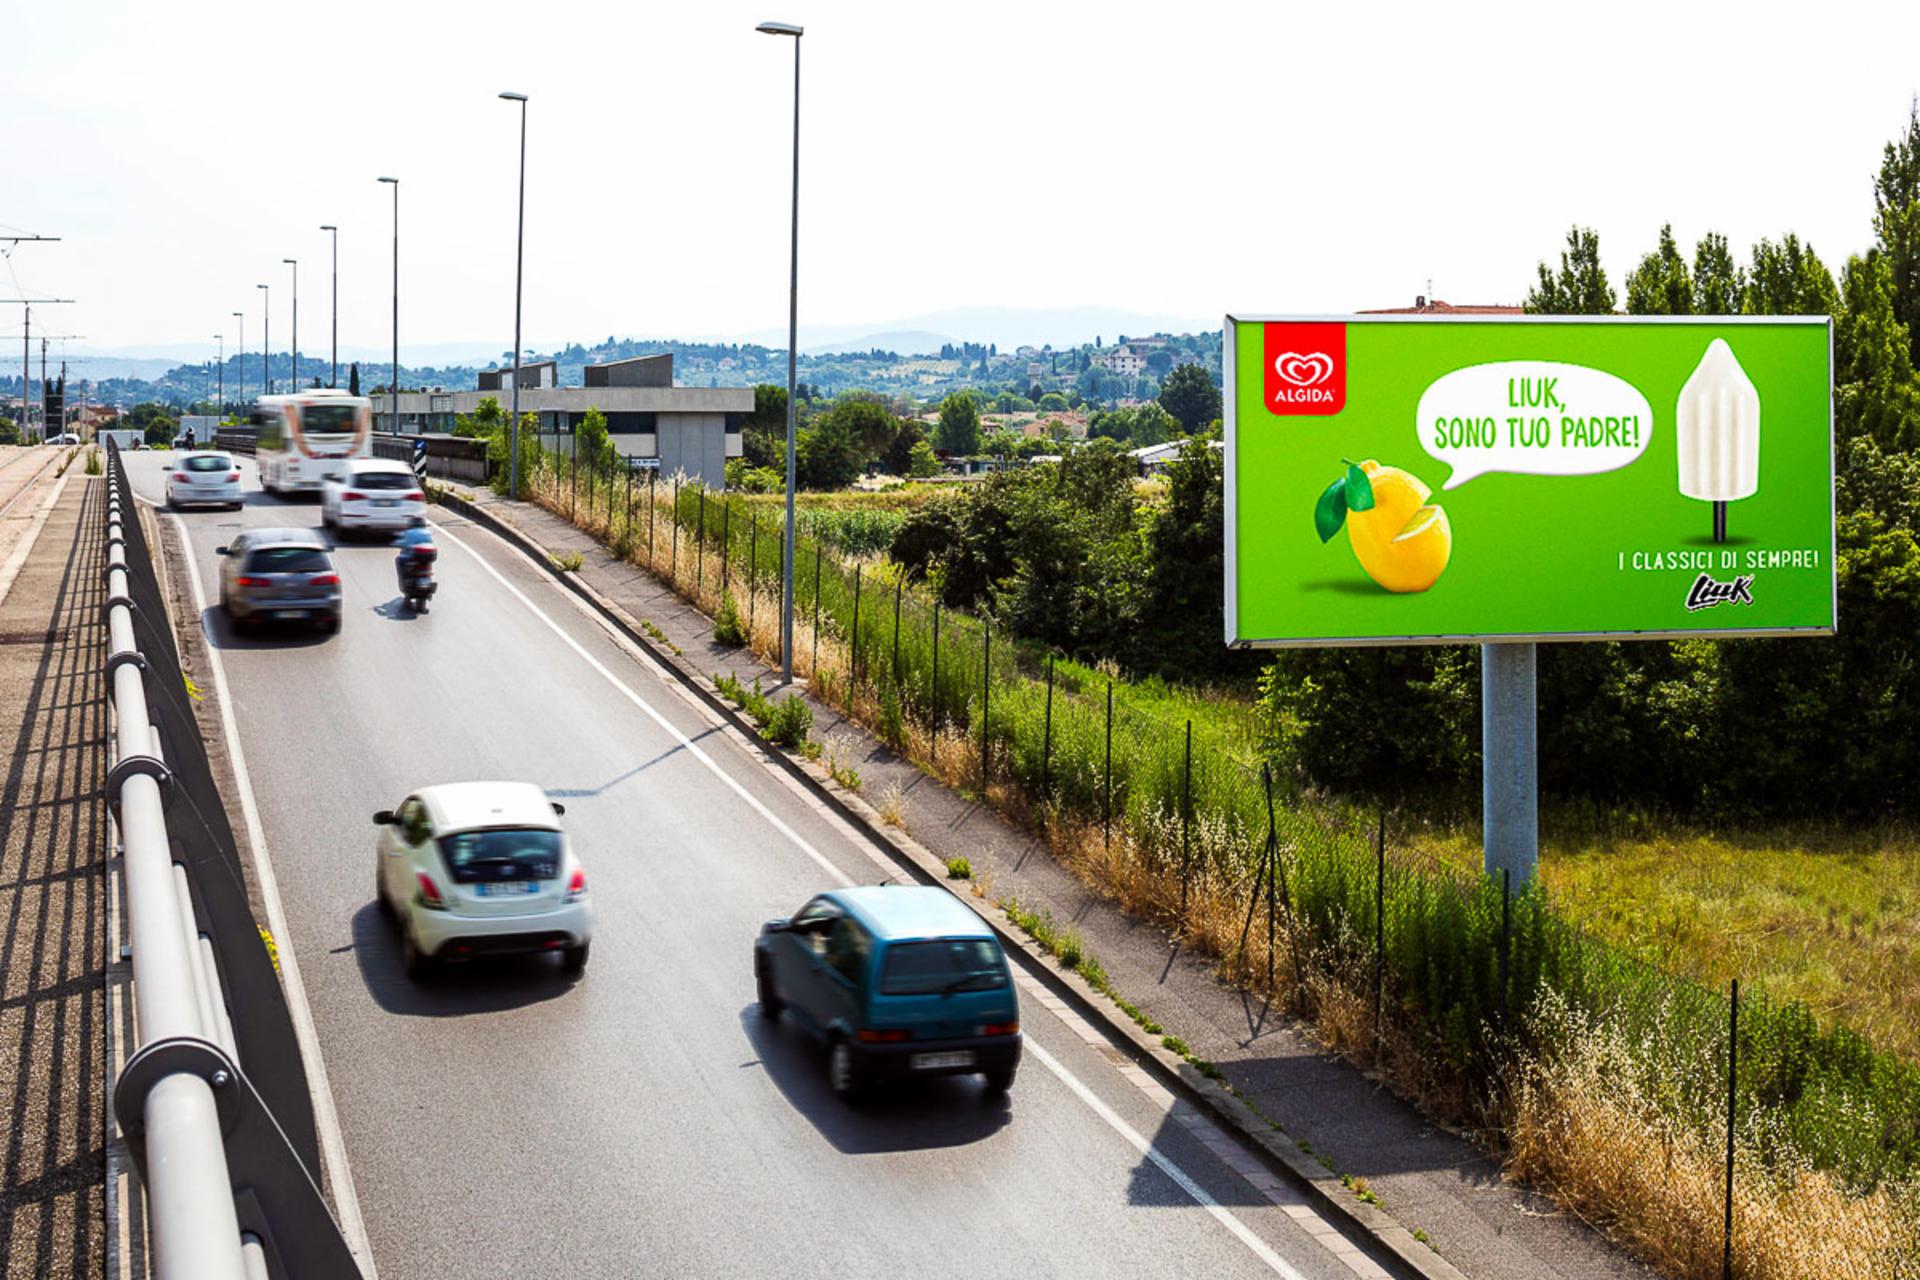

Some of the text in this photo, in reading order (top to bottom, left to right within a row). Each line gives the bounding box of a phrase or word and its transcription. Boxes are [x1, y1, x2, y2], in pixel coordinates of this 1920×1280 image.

[1275, 389, 1333, 402] ALGIDA
[1508, 377, 1566, 413] LIUK,
[1435, 416, 1639, 449] SONO TUO PADRE!
[1618, 550, 1820, 570] I CLASSICI DI SEMPRE!
